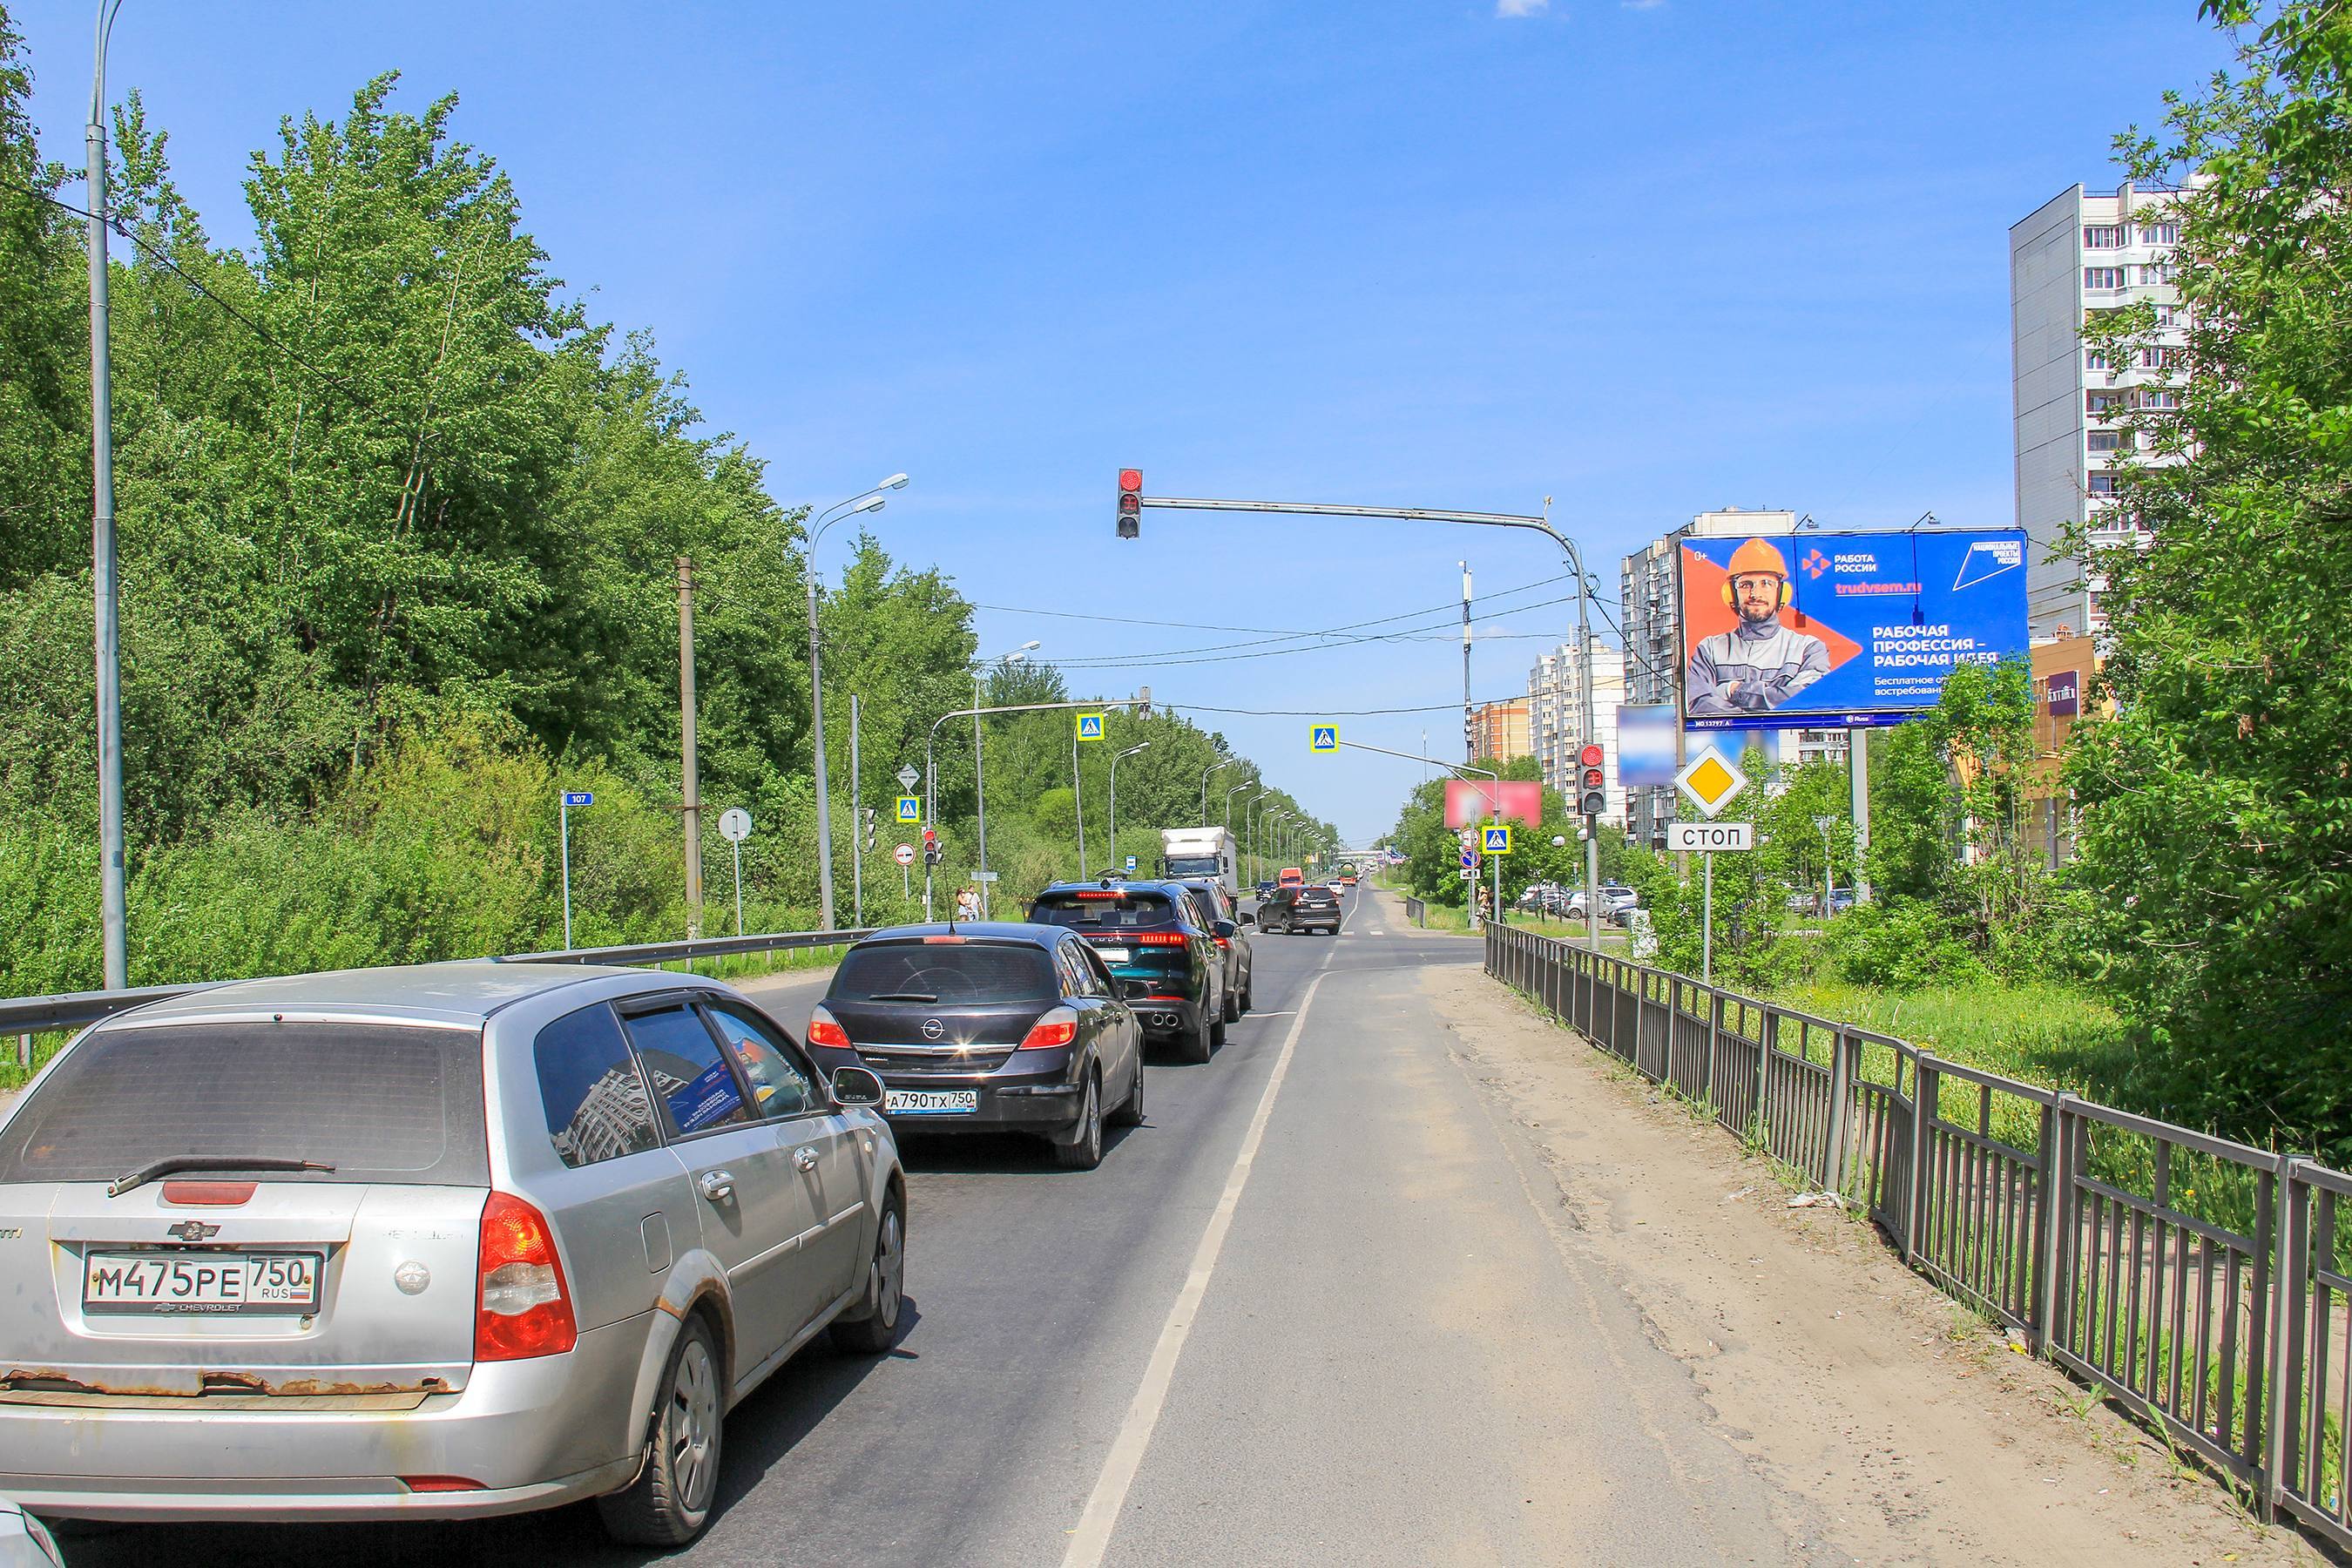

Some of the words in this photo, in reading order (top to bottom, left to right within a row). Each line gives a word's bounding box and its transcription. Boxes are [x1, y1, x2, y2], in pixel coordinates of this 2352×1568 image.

[1694, 551, 1707, 562] 0+
[1834, 554, 1874, 564] РАБОТА
[1834, 563, 1876, 573] РОССИИ
[1835, 582, 1923, 594] trudvsem.ru
[1873, 625, 1949, 639] РАБОЧАЯ
[1873, 639, 1973, 653] ПРОФЕССИЯ
[1874, 653, 1950, 667] РАБОЧАЯ
[1874, 677, 1934, 686] Бесплатное
[571, 794, 586, 803] 107
[1683, 828, 1740, 845] СТОП
[890, 1093, 950, 1108] А790ТХ
[951, 1092, 972, 1104] 750
[98, 1260, 241, 1297] М475РЕ
[250, 1258, 305, 1286] 750
[262, 1288, 289, 1299] RUS
[179, 1303, 242, 1313] CHEVROLET
